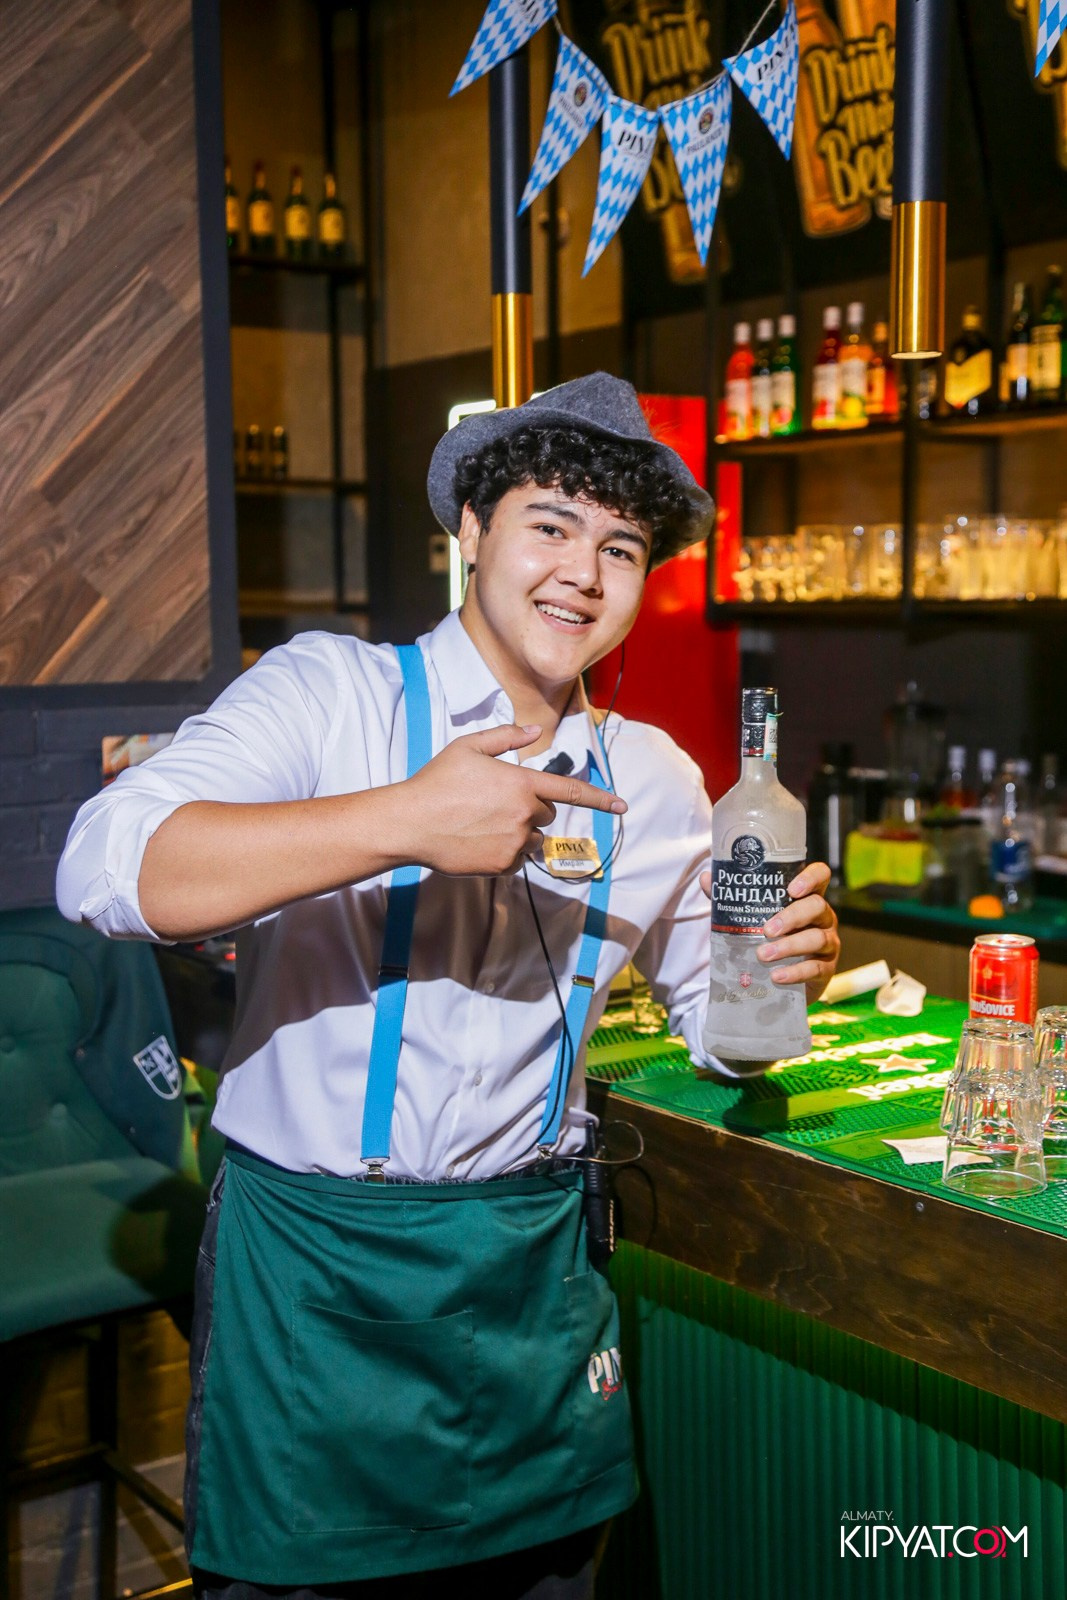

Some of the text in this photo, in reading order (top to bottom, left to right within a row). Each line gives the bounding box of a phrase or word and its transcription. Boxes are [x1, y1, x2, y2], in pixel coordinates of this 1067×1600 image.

[818, 129, 894, 208] Bee
[555, 842, 585, 853] PINTA
[711, 882, 792, 902] СТАНДАР
